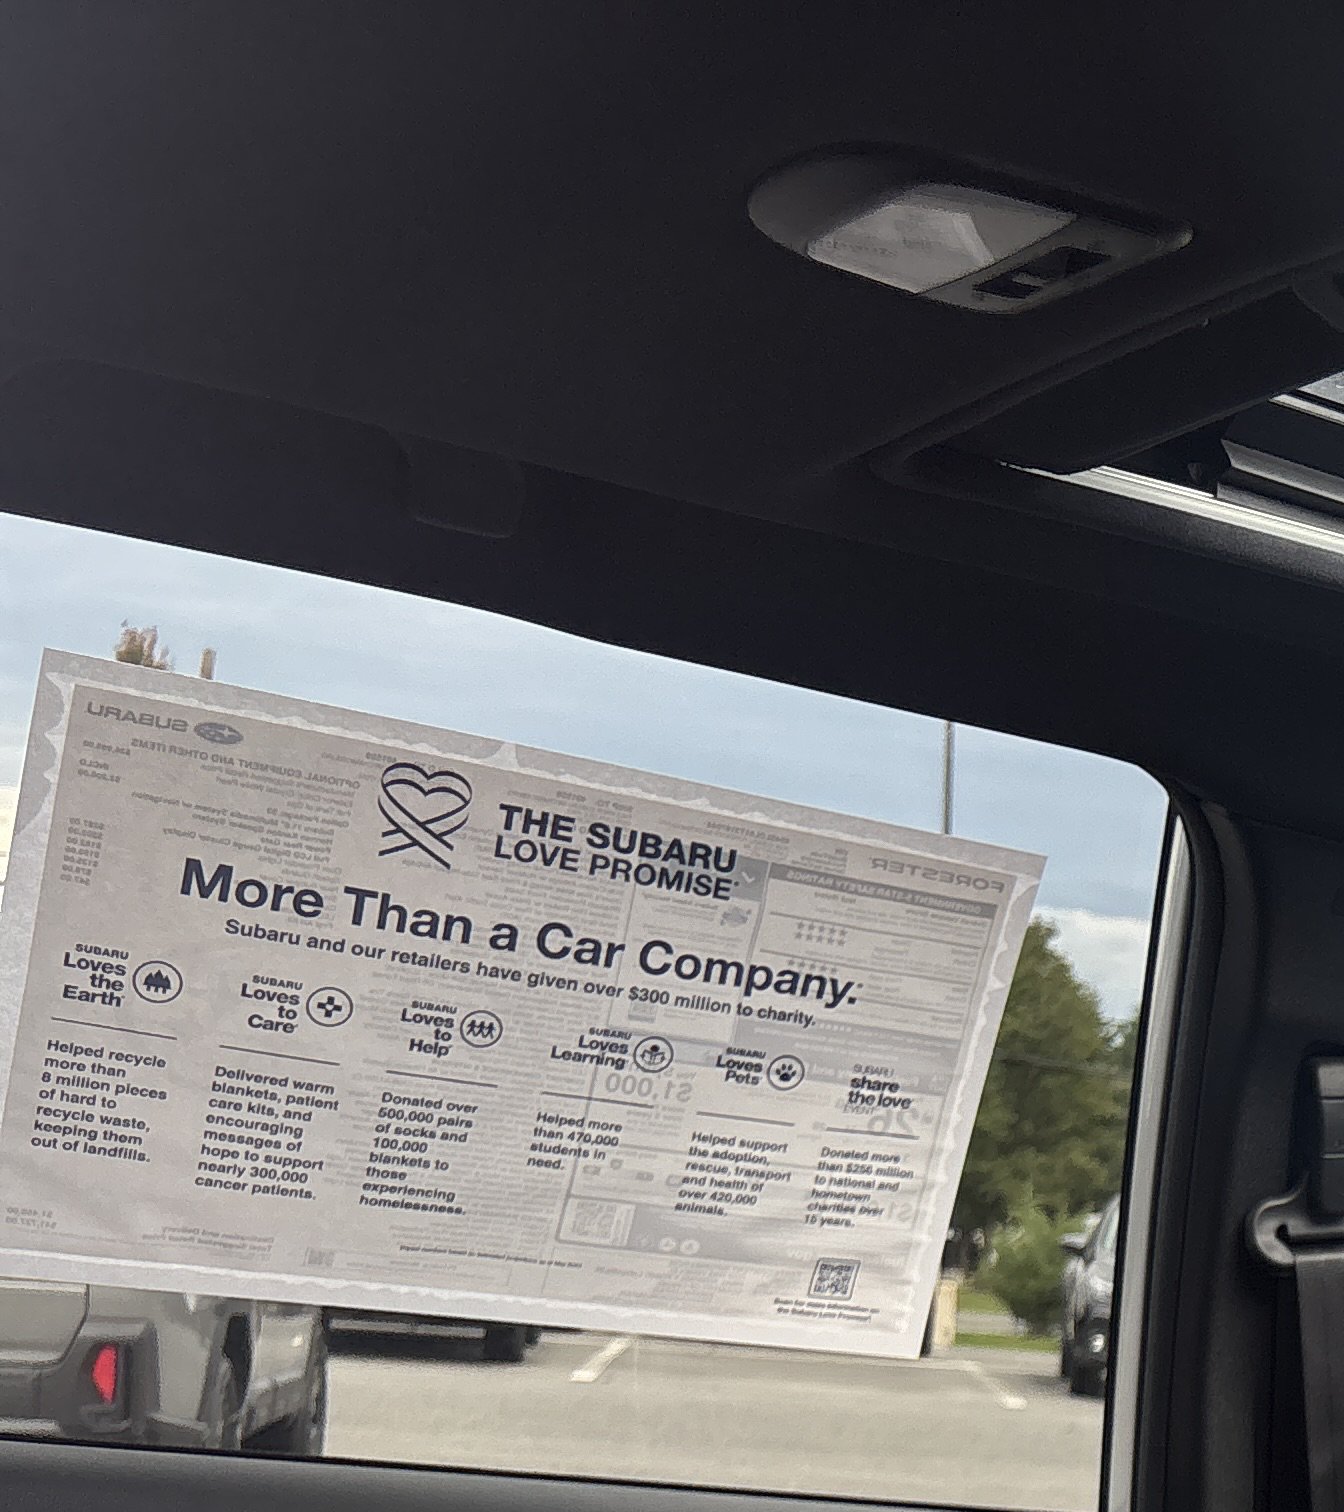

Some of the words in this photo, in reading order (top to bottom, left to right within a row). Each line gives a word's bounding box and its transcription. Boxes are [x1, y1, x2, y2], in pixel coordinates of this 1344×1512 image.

[499, 803, 576, 843] THE
[586, 822, 737, 873] SUBARU
[494, 834, 581, 873] LOVE
[588, 853, 733, 901] PROMISE
[180, 857, 324, 918] More
[343, 885, 473, 945] Than
[488, 923, 519, 952] a
[536, 922, 626, 969] Car
[75, 943, 129, 960] SUBARU
[63, 951, 127, 977] Loves
[224, 918, 301, 946] Subaru
[306, 936, 346, 953] and
[351, 944, 387, 960] our
[390, 950, 471, 974] retailers
[475, 961, 522, 982] have
[527, 971, 579, 992] given
[583, 982, 625, 998] over
[628, 985, 670, 1005] $300
[673, 994, 732, 1014] million
[736, 1002, 754, 1017] to
[756, 1006, 816, 1029] charity.
[89, 973, 125, 992] the
[252, 974, 303, 991] SUBARU
[62, 984, 124, 1008] Earth
[240, 982, 300, 1006] Loves
[277, 1005, 298, 1020] to
[400, 1007, 455, 1029] Loves
[410, 1000, 458, 1015] SUBARU
[247, 1013, 298, 1034] Care
[434, 1028, 453, 1042] to
[578, 1034, 629, 1055] Loves
[47, 1039, 105, 1059] Helped
[108, 1051, 167, 1068] recycle
[408, 1038, 453, 1058] Help
[44, 1057, 87, 1072] more
[90, 1062, 127, 1078] than
[715, 1054, 763, 1073] Loves
[214, 1065, 289, 1088] Delivered
[292, 1080, 335, 1095] warm
[724, 1067, 760, 1086] Pets
[850, 1075, 900, 1093] share
[55, 1075, 111, 1092] million
[114, 1083, 167, 1100] pieces
[211, 1080, 282, 1104] blankets,
[285, 1094, 339, 1111] patient
[848, 1090, 876, 1106] the
[38, 1088, 56, 1101] of
[59, 1089, 97, 1106] hard
[101, 1096, 117, 1109] to
[381, 1091, 443, 1110] Donated
[446, 1102, 479, 1114] over
[36, 1105, 95, 1123] recycle
[99, 1115, 150, 1133] waste,
[208, 1098, 243, 1112] care
[246, 1101, 279, 1119] kits,
[282, 1109, 313, 1122] and
[33, 1119, 98, 1142] keeping
[102, 1130, 143, 1146] them
[205, 1114, 304, 1140] encouraging
[374, 1122, 392, 1134] of
[393, 1126, 437, 1139] socks
[439, 1131, 468, 1143] and
[436, 1116, 473, 1129] pairs
[536, 1111, 586, 1128] Helped
[587, 1120, 623, 1133] more
[203, 1130, 282, 1150] messages
[285, 1141, 303, 1153] of
[533, 1126, 564, 1140] than
[691, 1131, 737, 1147] Helped
[738, 1139, 789, 1153] support
[30, 1137, 58, 1150] out
[61, 1140, 80, 1152] of
[82, 1141, 150, 1163] landfills.
[373, 1136, 428, 1154] 100,000
[529, 1142, 590, 1159] students
[593, 1148, 606, 1160] in
[687, 1146, 709, 1158] the
[820, 1146, 870, 1161] Donated
[870, 1153, 901, 1164] more
[200, 1143, 240, 1160] hope
[244, 1150, 260, 1162] to
[263, 1154, 324, 1171] support
[368, 1151, 431, 1169] blankets
[434, 1159, 450, 1171] to
[197, 1161, 246, 1178] nearly
[365, 1166, 408, 1181] those
[685, 1161, 731, 1176] rescue,
[734, 1166, 792, 1182] transport
[816, 1161, 844, 1172] than
[874, 1166, 914, 1180] million
[194, 1176, 249, 1191] cancer
[251, 1184, 316, 1200] patients.
[362, 1182, 456, 1203] experiencing
[681, 1176, 707, 1187] and
[709, 1177, 748, 1190] health
[750, 1182, 765, 1193] of
[814, 1174, 827, 1185] to
[828, 1176, 876, 1190] national
[876, 1181, 901, 1193] and
[678, 1189, 707, 1200] over
